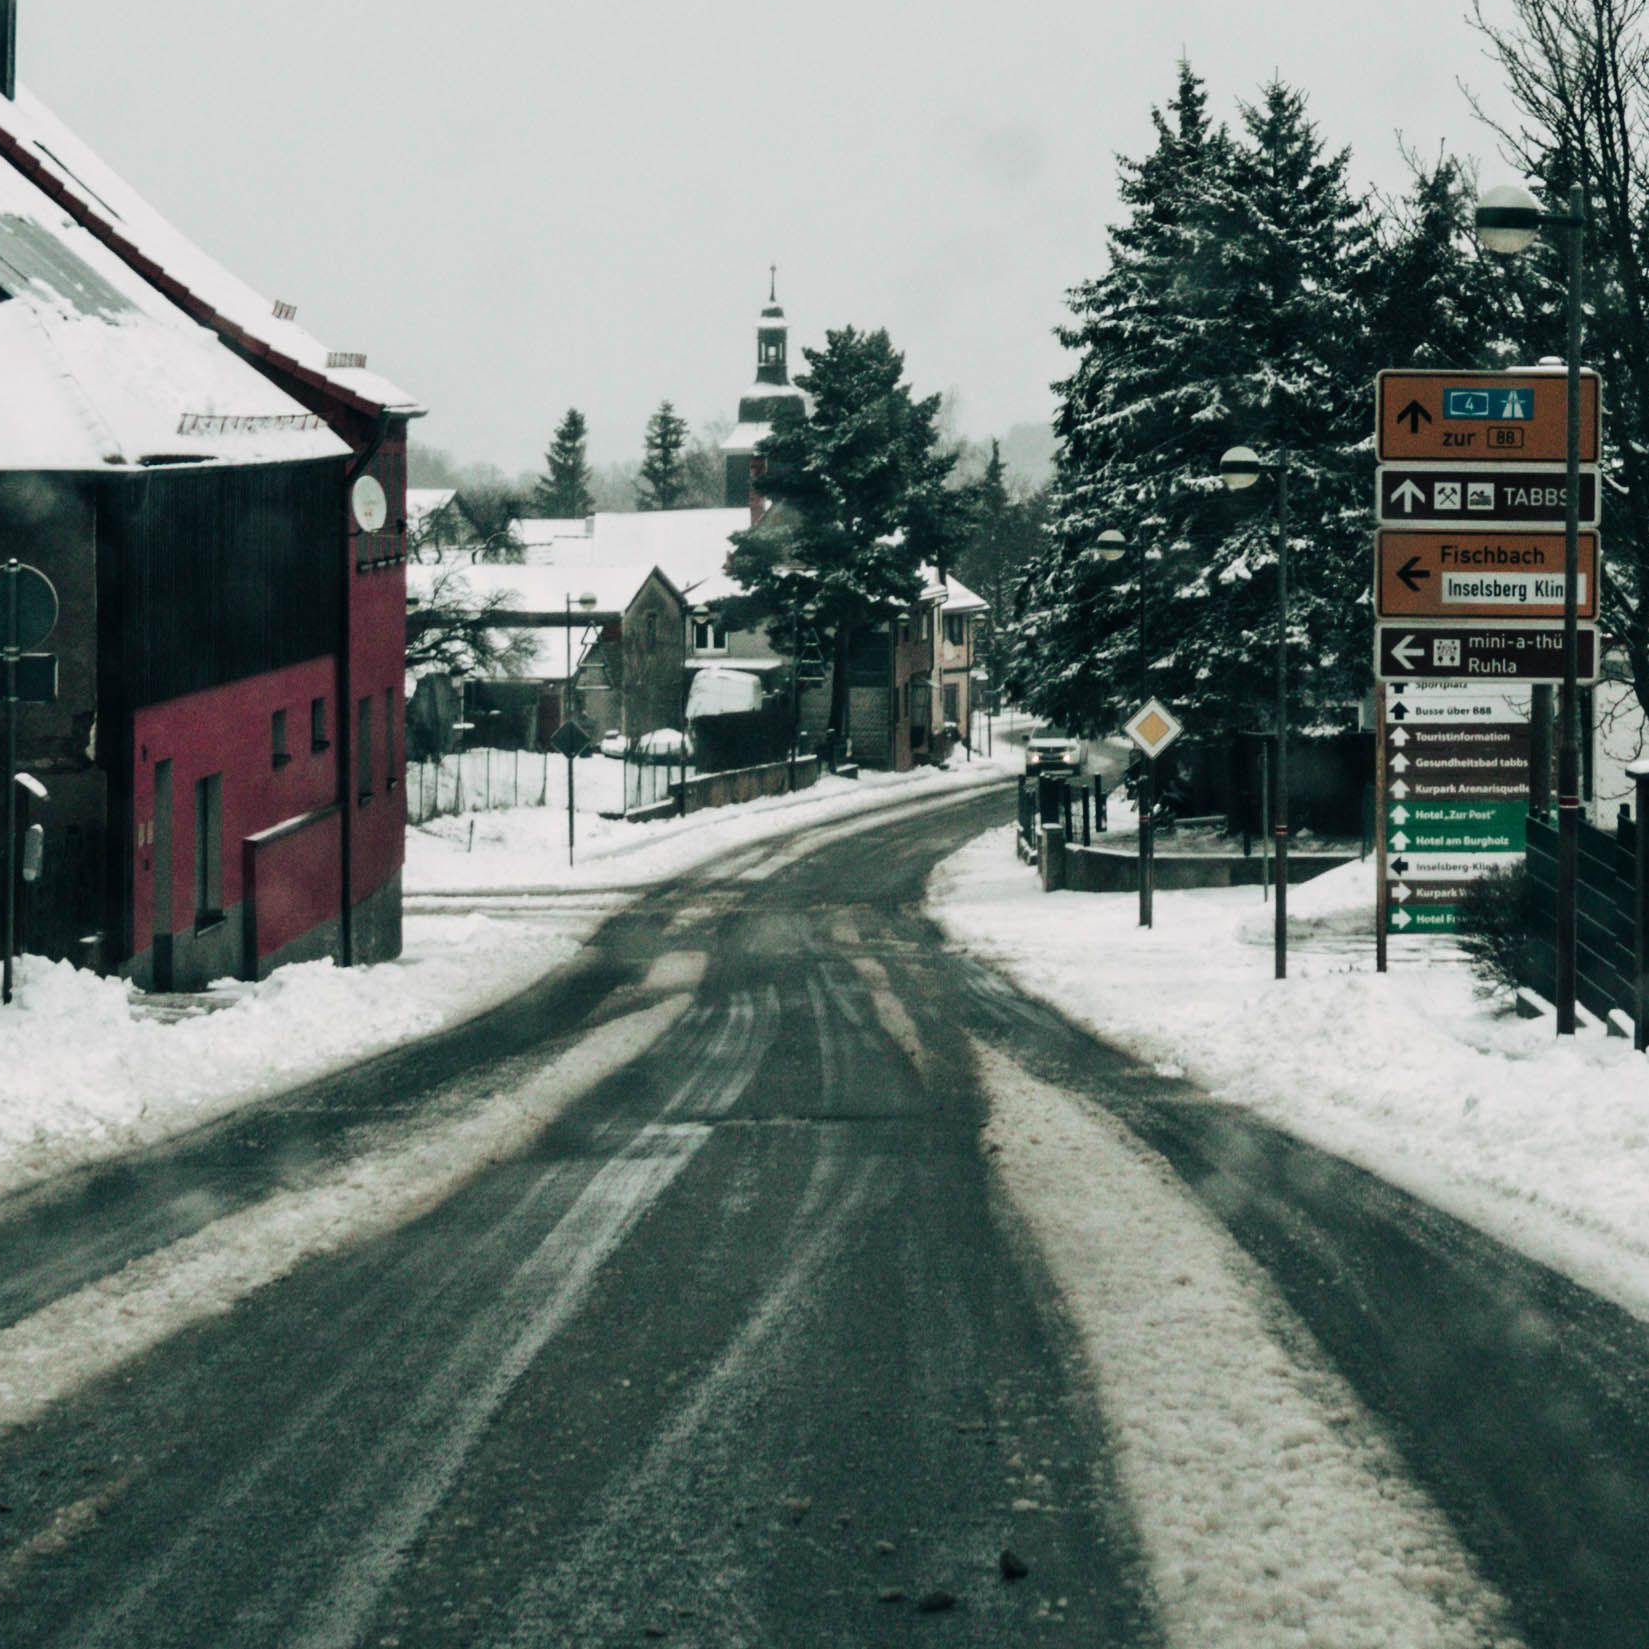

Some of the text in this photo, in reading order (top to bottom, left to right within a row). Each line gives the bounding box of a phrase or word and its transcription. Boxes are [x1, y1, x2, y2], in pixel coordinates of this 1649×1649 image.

[1465, 396, 1474, 410] 4
[1443, 430, 1515, 447] zur 88
[1440, 545, 1545, 565] Fischbach
[1448, 578, 1564, 602] Inselsberg Klin
[1468, 633, 1563, 650] mini-a-thü
[1468, 657, 1517, 674] Ruhla
[1415, 707, 1444, 716] Busse
[1447, 706, 1470, 716] über
[1415, 732, 1511, 742] Touristinformation
[1415, 757, 1529, 768] Gesundheitsbad tabbs
[1415, 784, 1457, 796] Kurpark
[1415, 810, 1444, 820] Hotel
[1415, 835, 1444, 846] Hotel
[1445, 837, 1462, 846] am
[1415, 887, 1457, 899] Kurpark
[1416, 913, 1445, 924] Hotel
